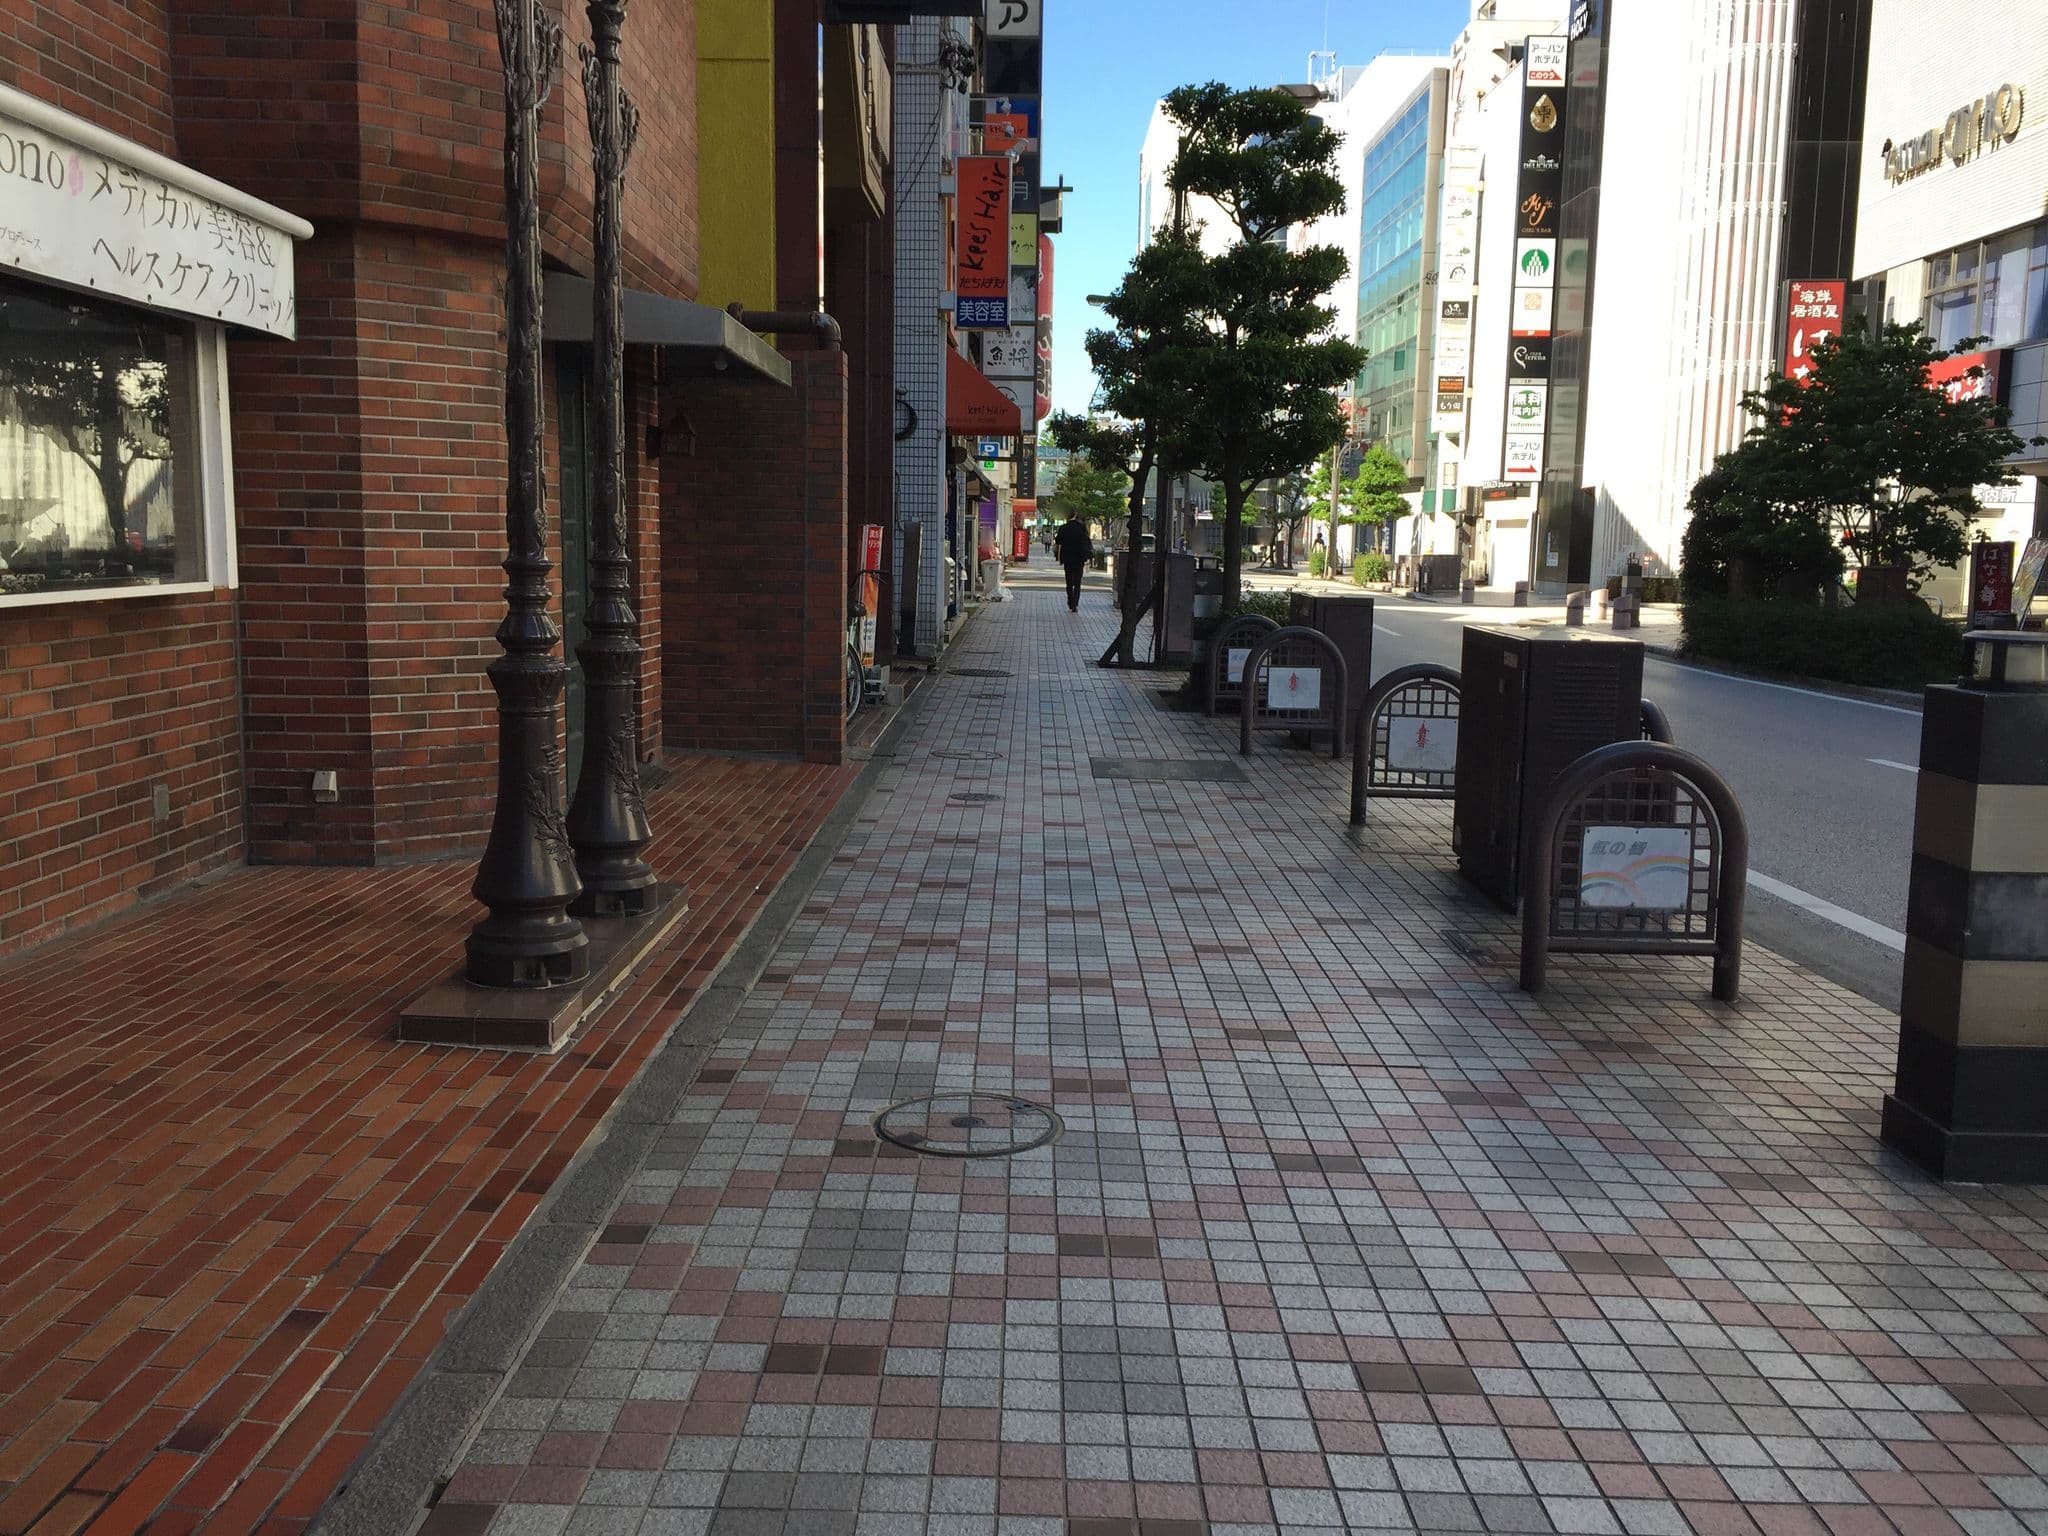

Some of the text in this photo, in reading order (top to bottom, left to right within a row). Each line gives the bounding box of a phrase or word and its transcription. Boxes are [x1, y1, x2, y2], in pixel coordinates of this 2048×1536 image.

[1534, 55, 1560, 64] ホテル
[973, 161, 1007, 219] Hair
[1800, 289, 1832, 303] 海鮮
[959, 300, 1005, 321] 美容室
[1791, 304, 1839, 318] 居酒屋
[1513, 392, 1541, 407] 無料
[1512, 407, 1541, 417] 案内所
[984, 444, 995, 453] P
[1512, 452, 1536, 461] ホテル
